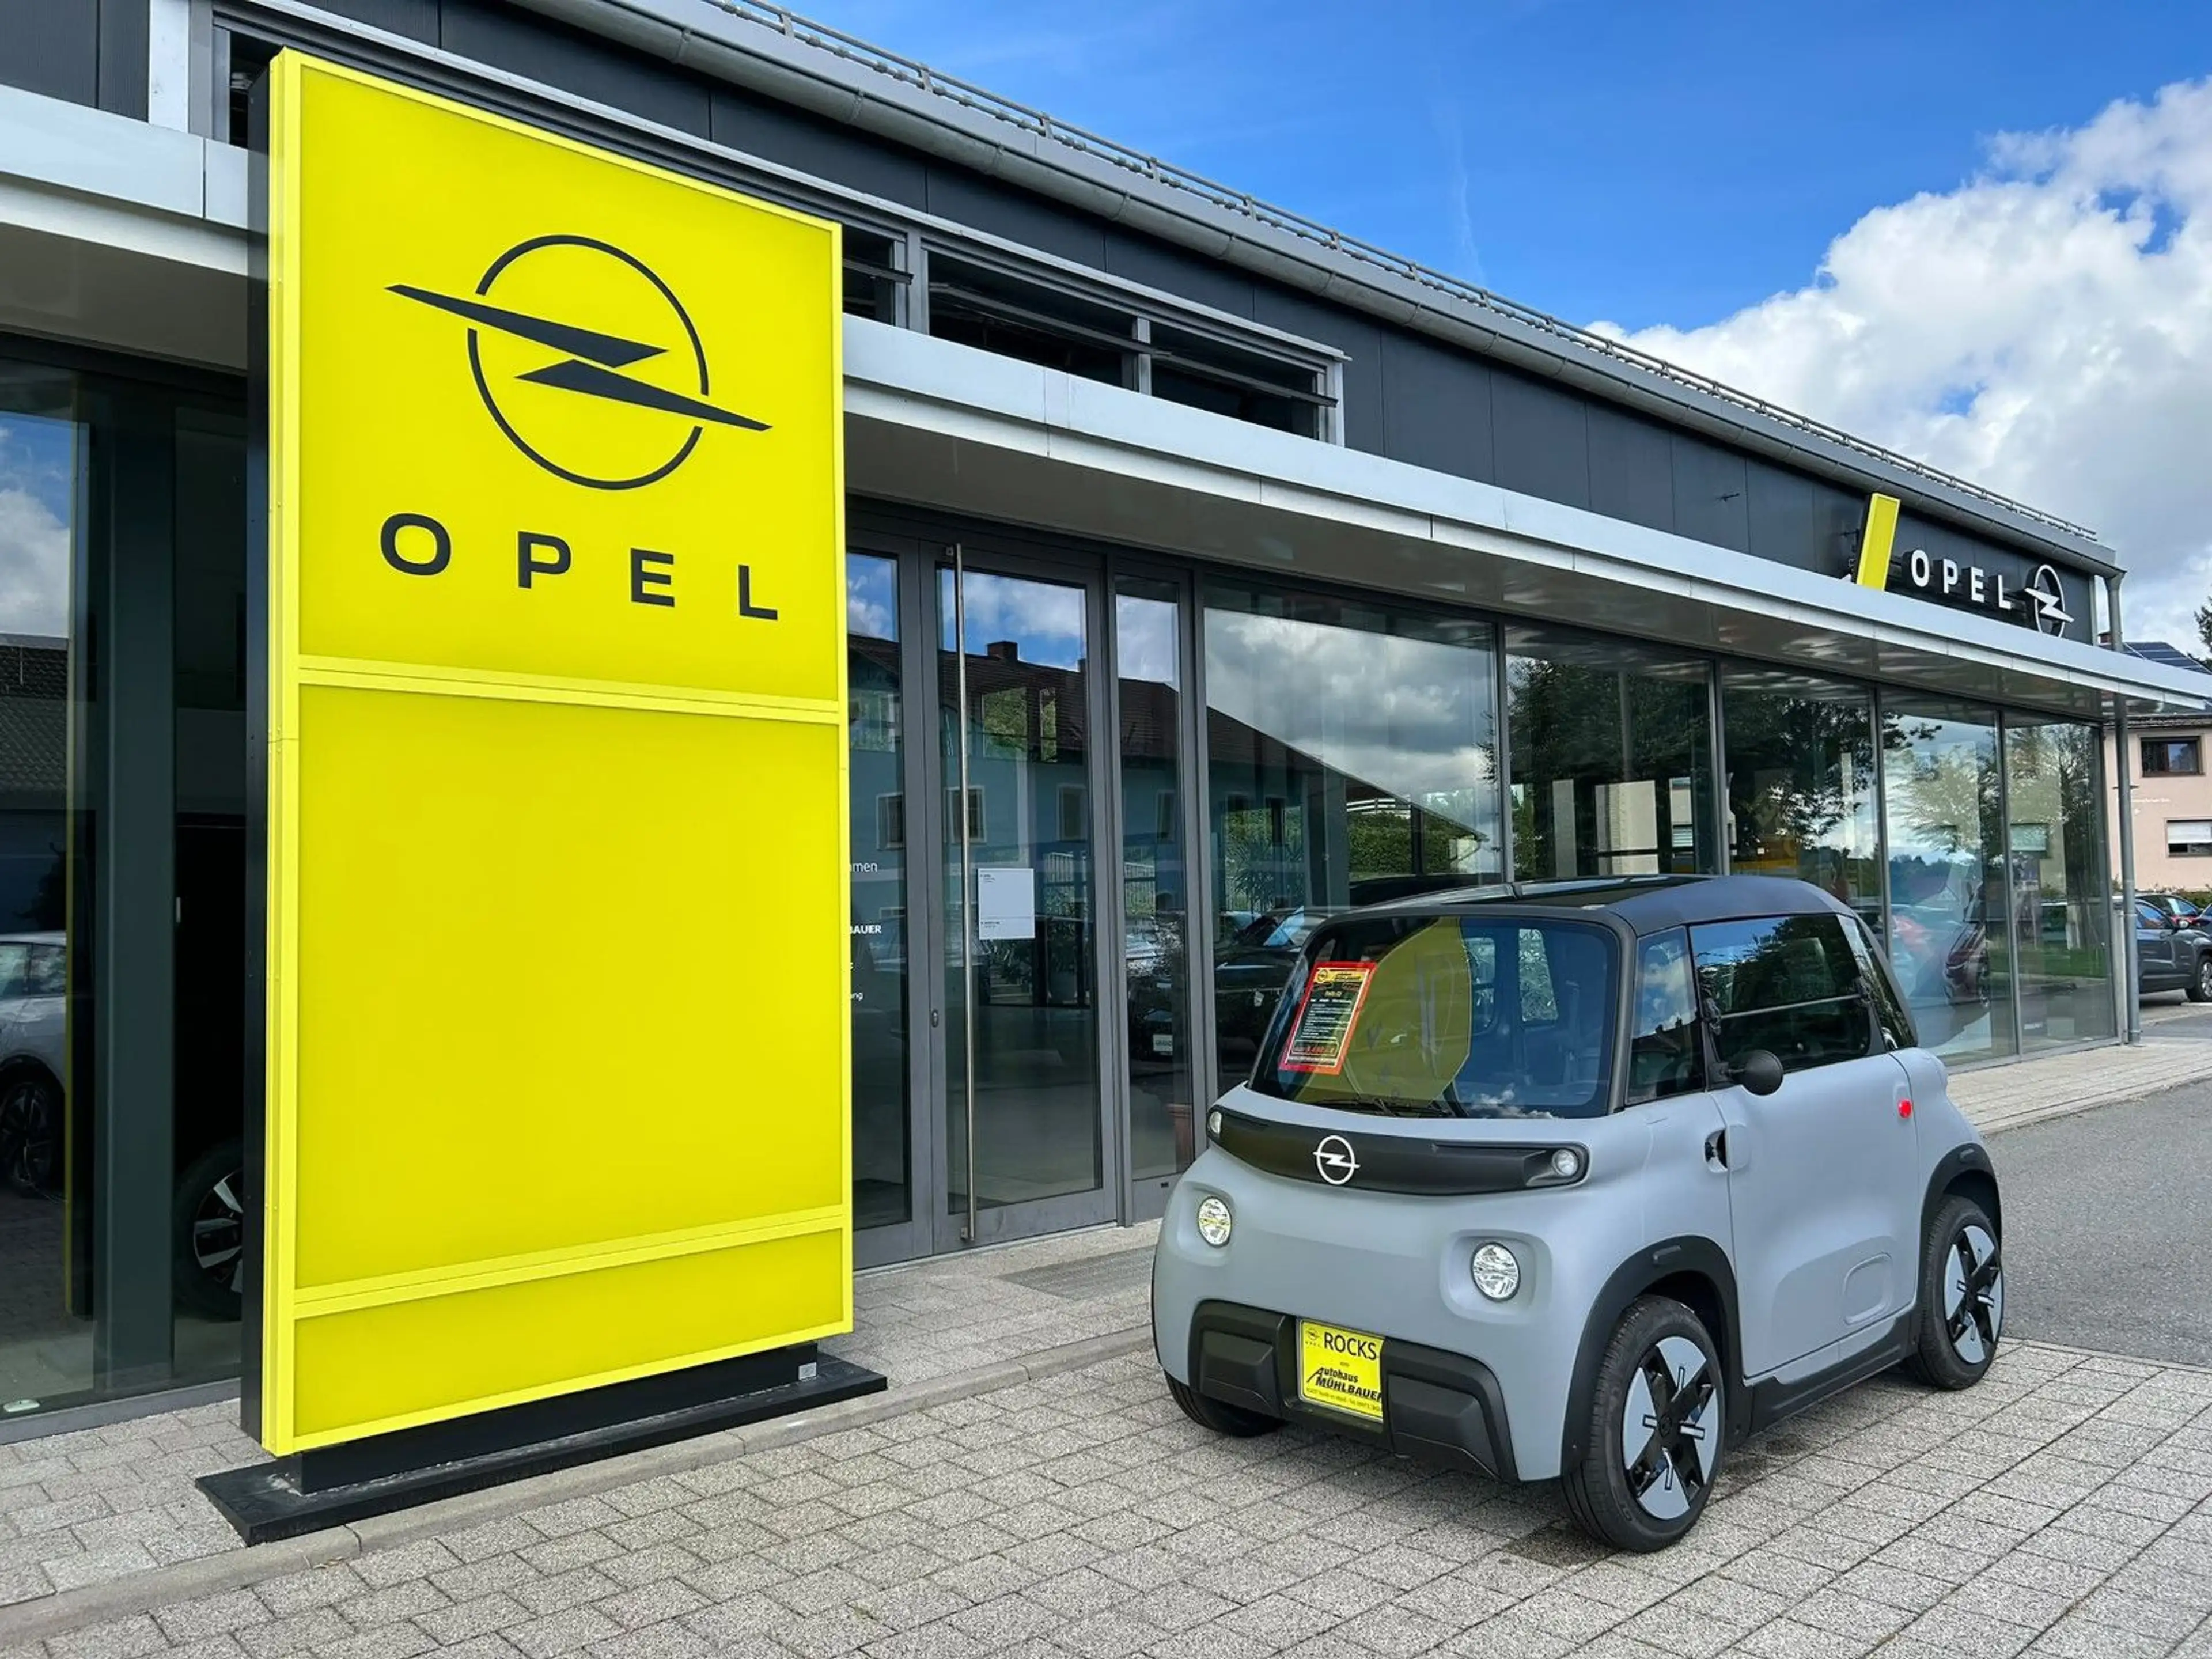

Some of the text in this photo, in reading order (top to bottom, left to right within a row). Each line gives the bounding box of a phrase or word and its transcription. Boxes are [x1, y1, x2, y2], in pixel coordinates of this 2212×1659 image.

[380, 513, 778, 620] OPEL
[1911, 549, 2012, 610] OPEL
[850, 862, 877, 872] men
[1324, 1331, 1377, 1361] ROCKS
[1306, 1366, 1358, 1383] Autohaus
